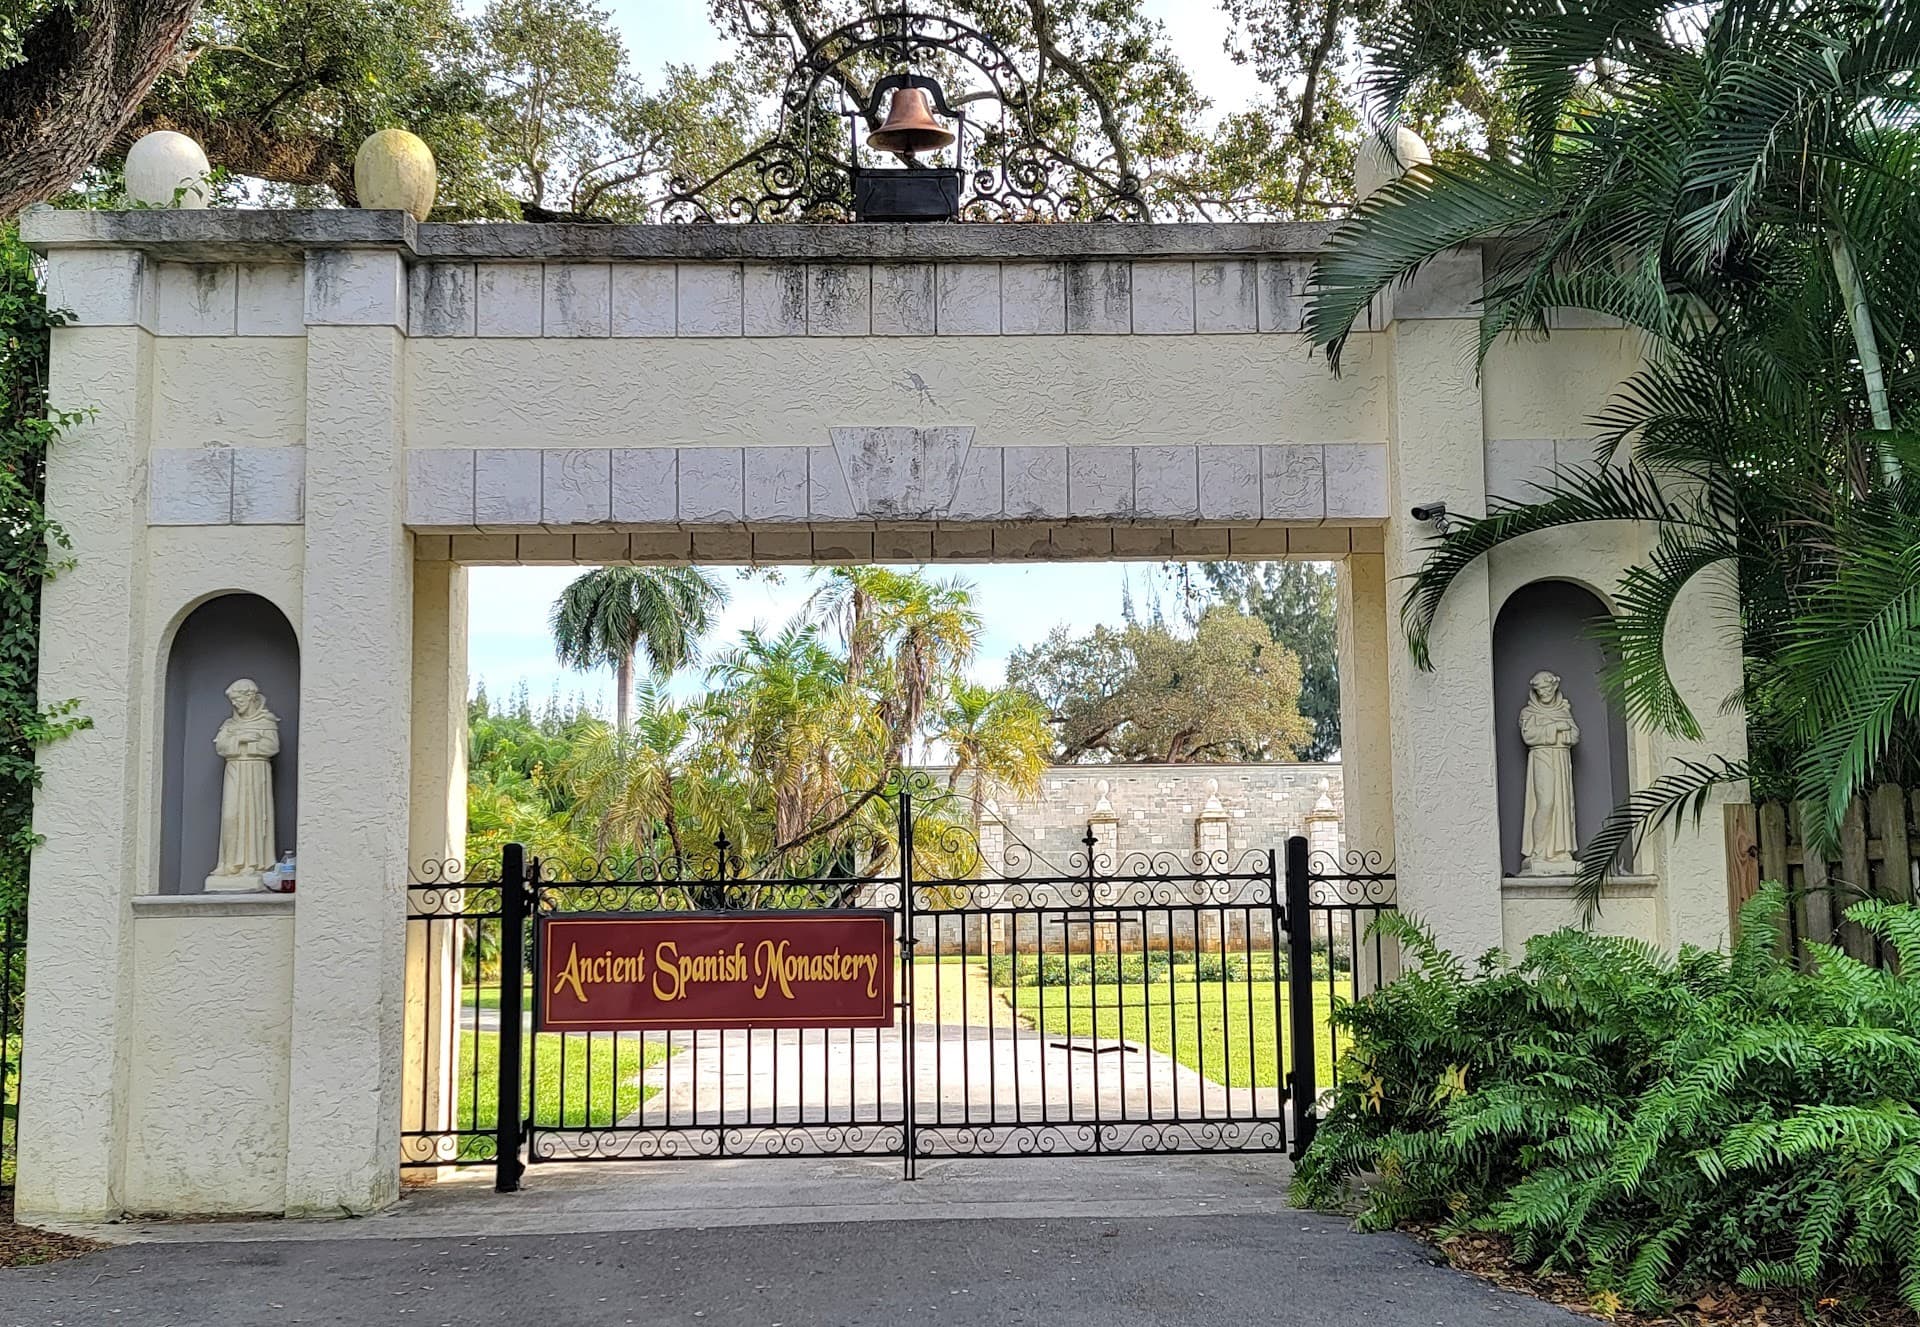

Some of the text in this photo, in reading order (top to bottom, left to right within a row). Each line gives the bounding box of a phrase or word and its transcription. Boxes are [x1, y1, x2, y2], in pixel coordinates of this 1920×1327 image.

[553, 940, 878, 1002] Ancient Spanish Monastery
